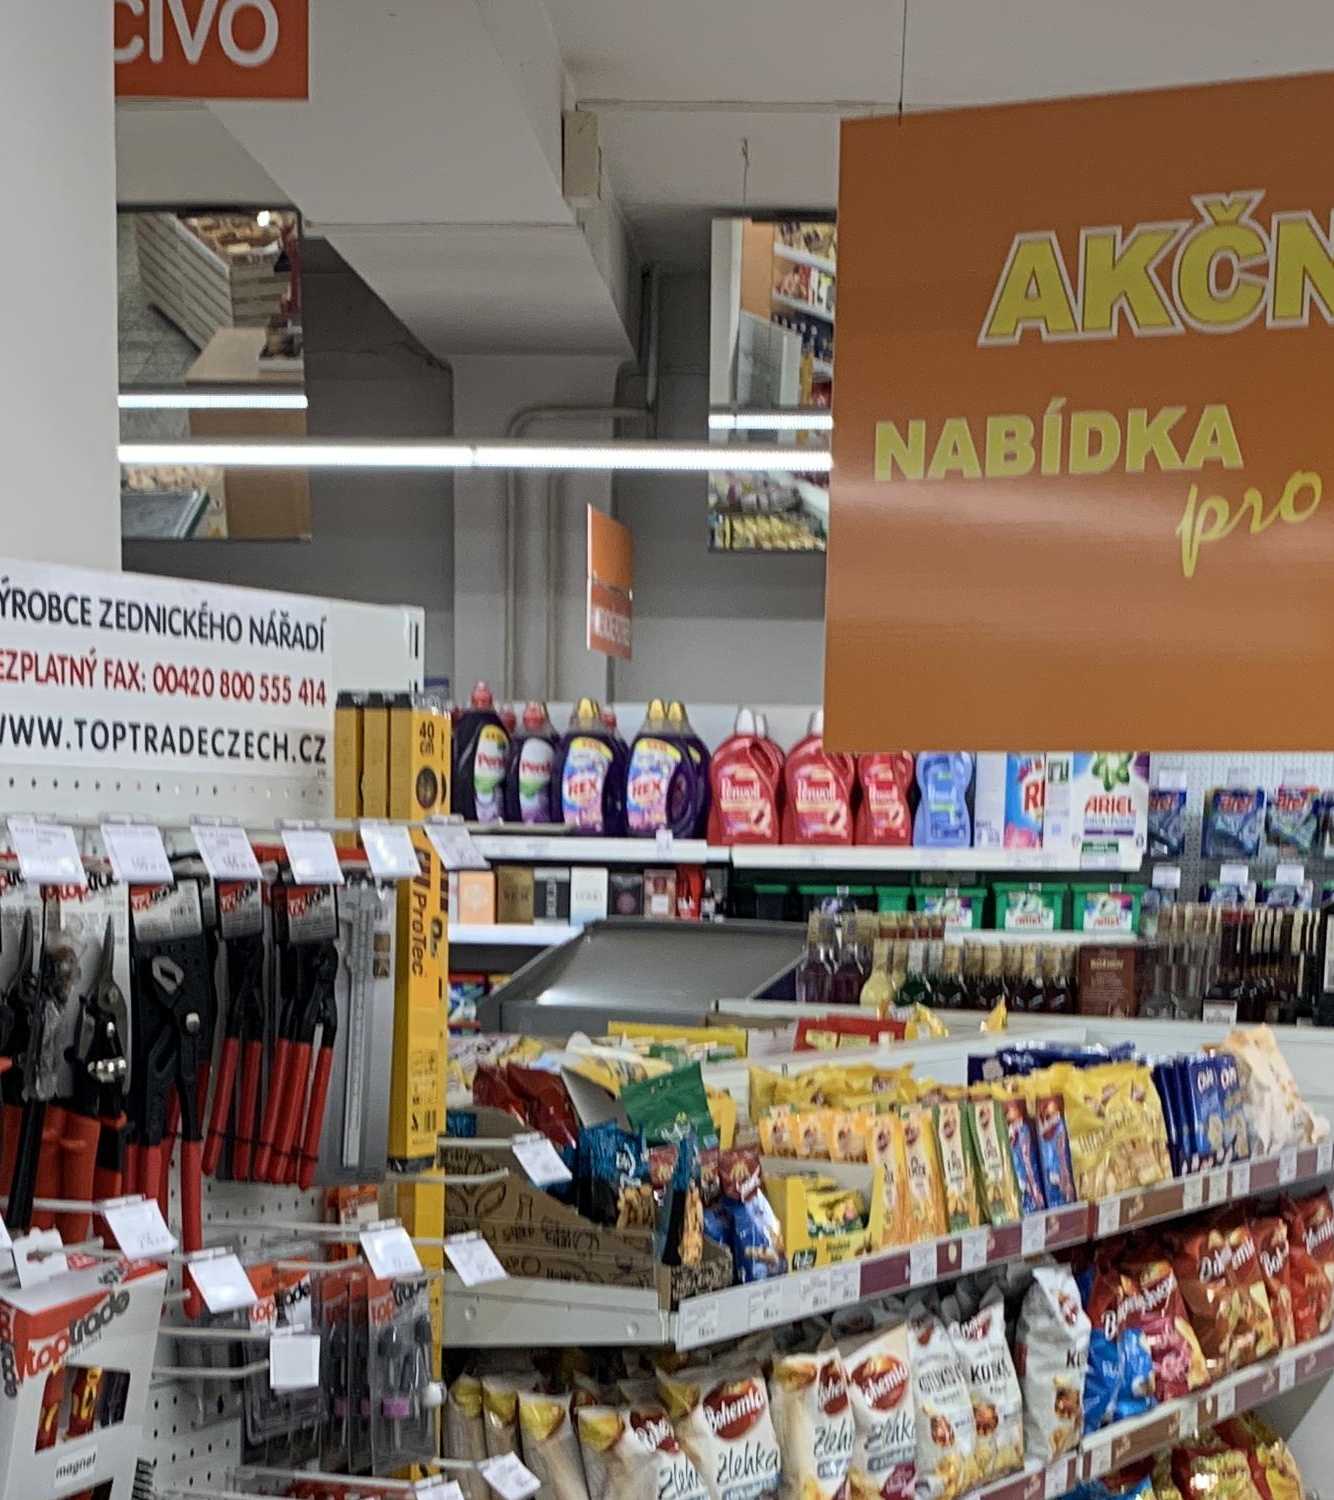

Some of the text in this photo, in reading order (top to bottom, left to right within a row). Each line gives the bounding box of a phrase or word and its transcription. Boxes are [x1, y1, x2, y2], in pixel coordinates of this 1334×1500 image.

[873, 398, 1244, 483] NABÍDKA
[1176, 469, 1323, 580] pro
[99, 599, 242, 645] ZEDNICKÉHO
[250, 608, 328, 654] NÁŘADÍ
[104, 659, 146, 695] FAX:
[153, 665, 215, 697] 00420
[220, 670, 255, 701] 800
[260, 675, 292, 704] 555
[298, 678, 327, 708] 414
[1085, 795, 1135, 816] ARIEL
[55, 1453, 97, 1479] magnet
